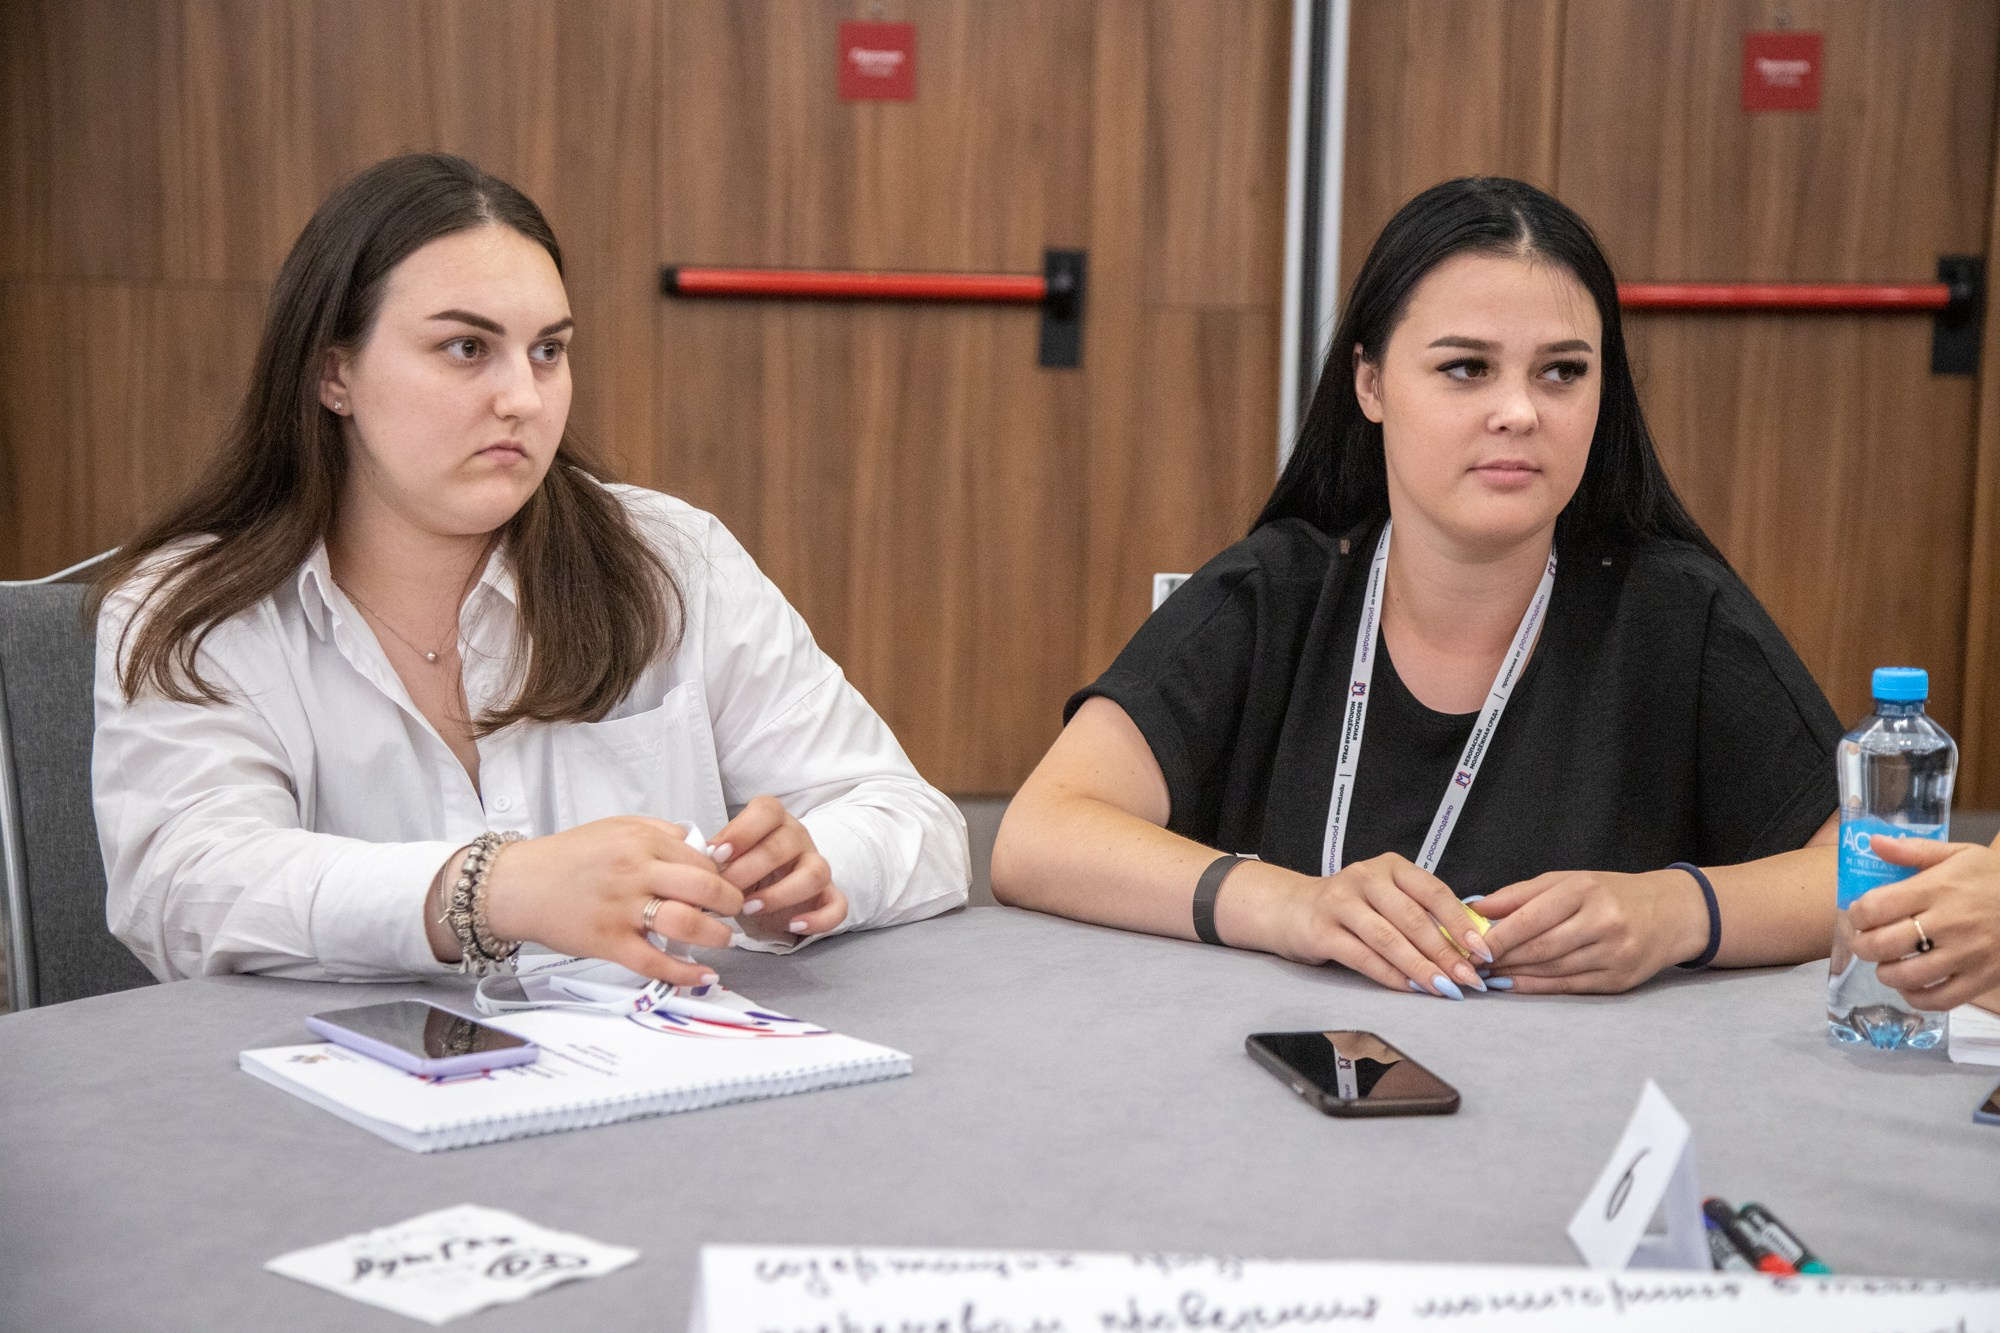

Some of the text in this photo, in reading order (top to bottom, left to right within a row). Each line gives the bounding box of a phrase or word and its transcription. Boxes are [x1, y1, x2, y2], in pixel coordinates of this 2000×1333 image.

[1361, 607, 1374, 663] росмолодёжь
[1518, 594, 1545, 650] росмолодёжь
[1353, 701, 1363, 741] БЕЗОПАСНАЯ
[1463, 728, 1483, 767] БЕЗОПАСНАЯ
[1469, 708, 1499, 769] МОЛОДЁЖНАЯ СРЕДА
[1341, 744, 1349, 764] СРЕДА
[1328, 825, 1339, 876] росмолодё
[1427, 804, 1454, 862] росмолодёжь
[1605, 1147, 1650, 1221] 6
